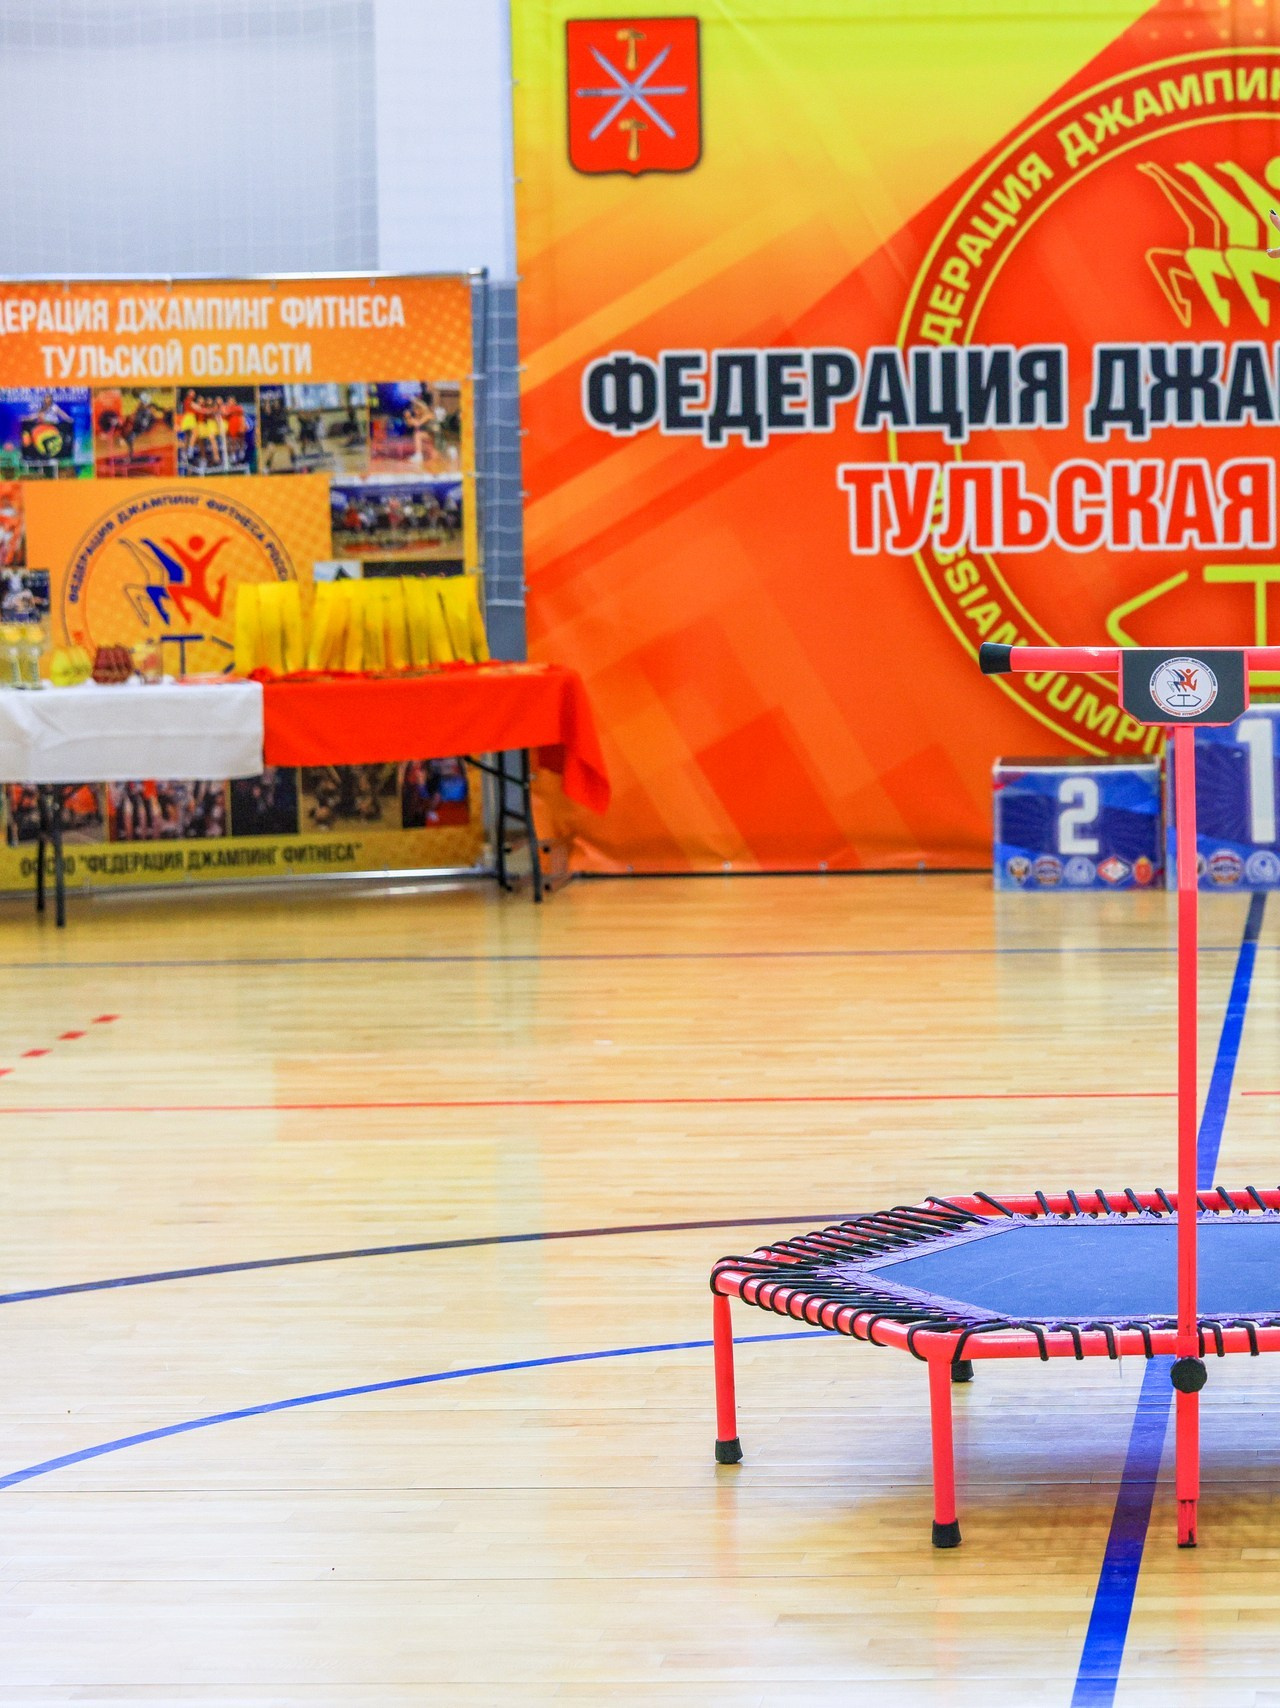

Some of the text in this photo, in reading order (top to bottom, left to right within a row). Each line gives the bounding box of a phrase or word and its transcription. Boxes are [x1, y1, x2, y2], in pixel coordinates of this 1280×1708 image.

[920, 152, 1054, 347] ДЕРАЦИЯ
[115, 296, 271, 334] ДЖАМПИНГ
[280, 295, 406, 328] ФИТНЕСА
[41, 340, 312, 378] ТУЛЬСКОЙ ОБЛАСТИ
[584, 346, 1067, 447] ФЕДЕРАЦИЯ
[838, 456, 1276, 555] ТУЛЬСКАЯ
[265, 541, 289, 583] РОСС
[1024, 672, 1167, 759] JUMPI
[1057, 777, 1100, 855] 2
[1236, 717, 1277, 844] 1
[187, 848, 278, 872] ДЖАМПИНГ
